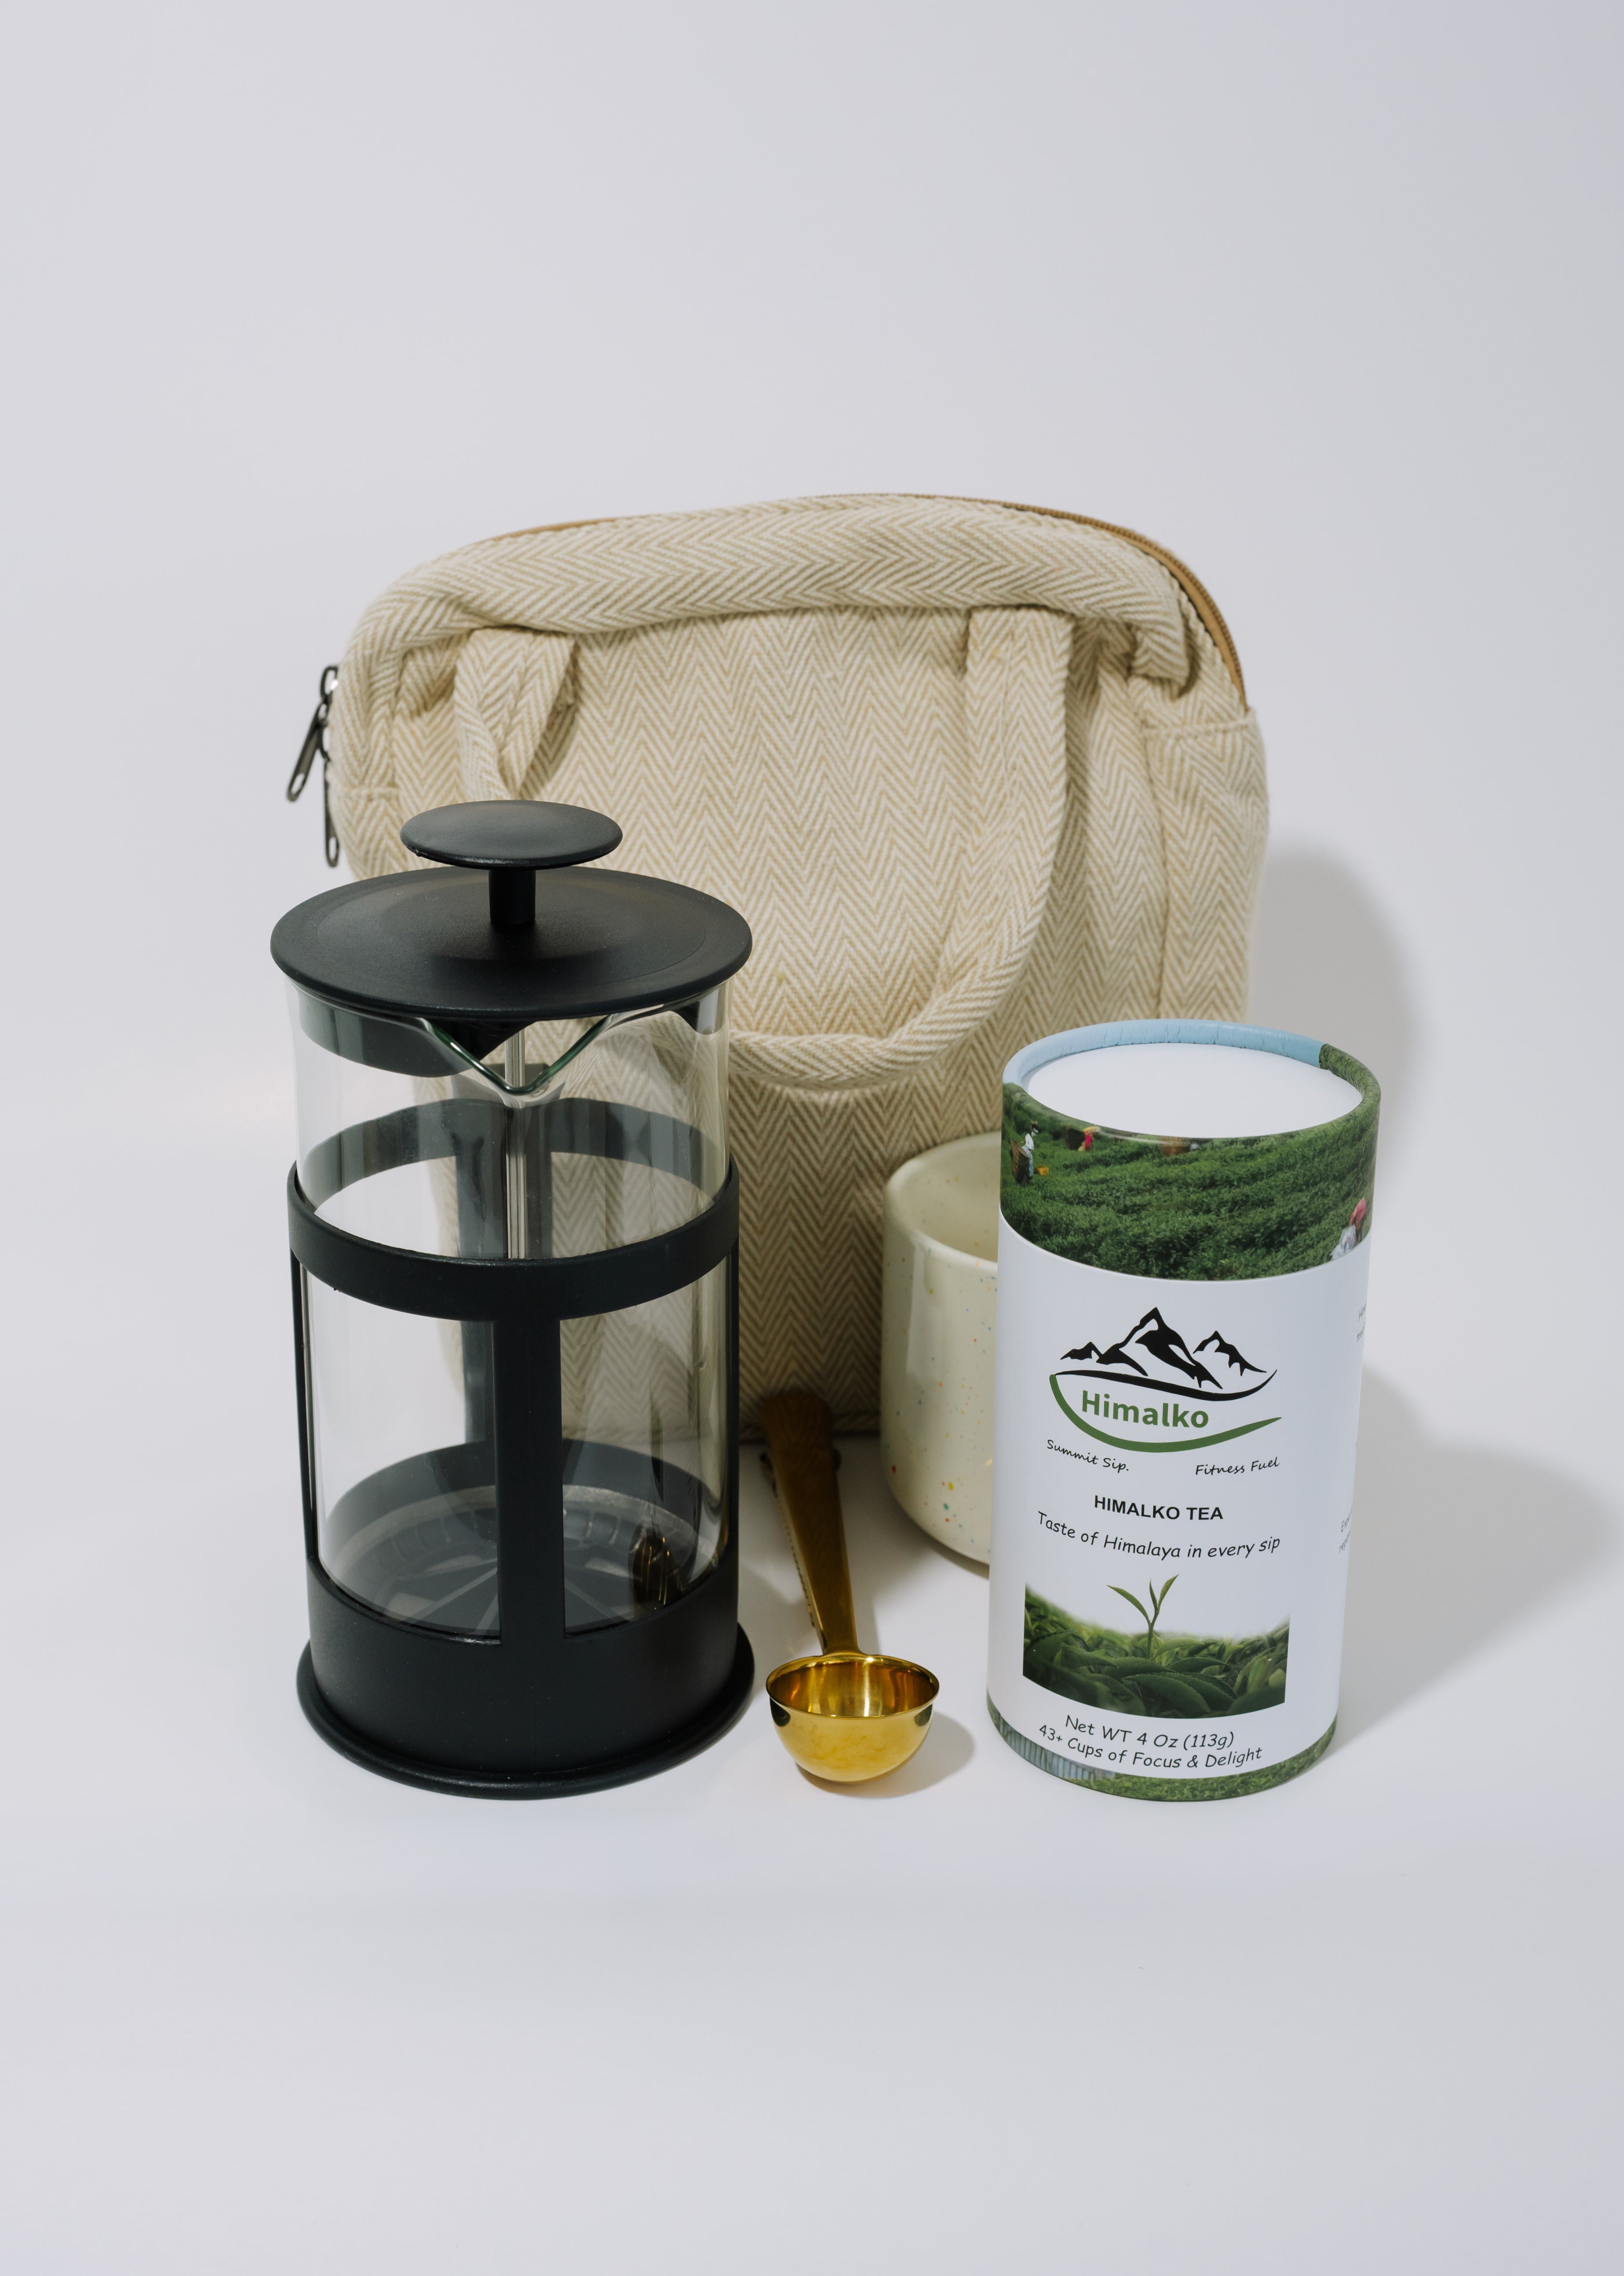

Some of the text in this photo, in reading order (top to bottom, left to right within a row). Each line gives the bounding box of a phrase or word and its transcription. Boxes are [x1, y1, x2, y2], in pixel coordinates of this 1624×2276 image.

[1082, 1390, 1209, 1428] Himalko
[1047, 1439, 1129, 1474] Summit Sip.
[1195, 1456, 1280, 1476] Fitness Fuel
[1094, 1495, 1223, 1520] HIMALKO TEA
[1038, 1511, 1280, 1561] Taste of Himalaya in every sip
[1038, 1725, 1262, 1768] 43+ Cups of Focus & Delight
[1065, 1715, 1234, 1751] Net WT 4 Oz (113g)
